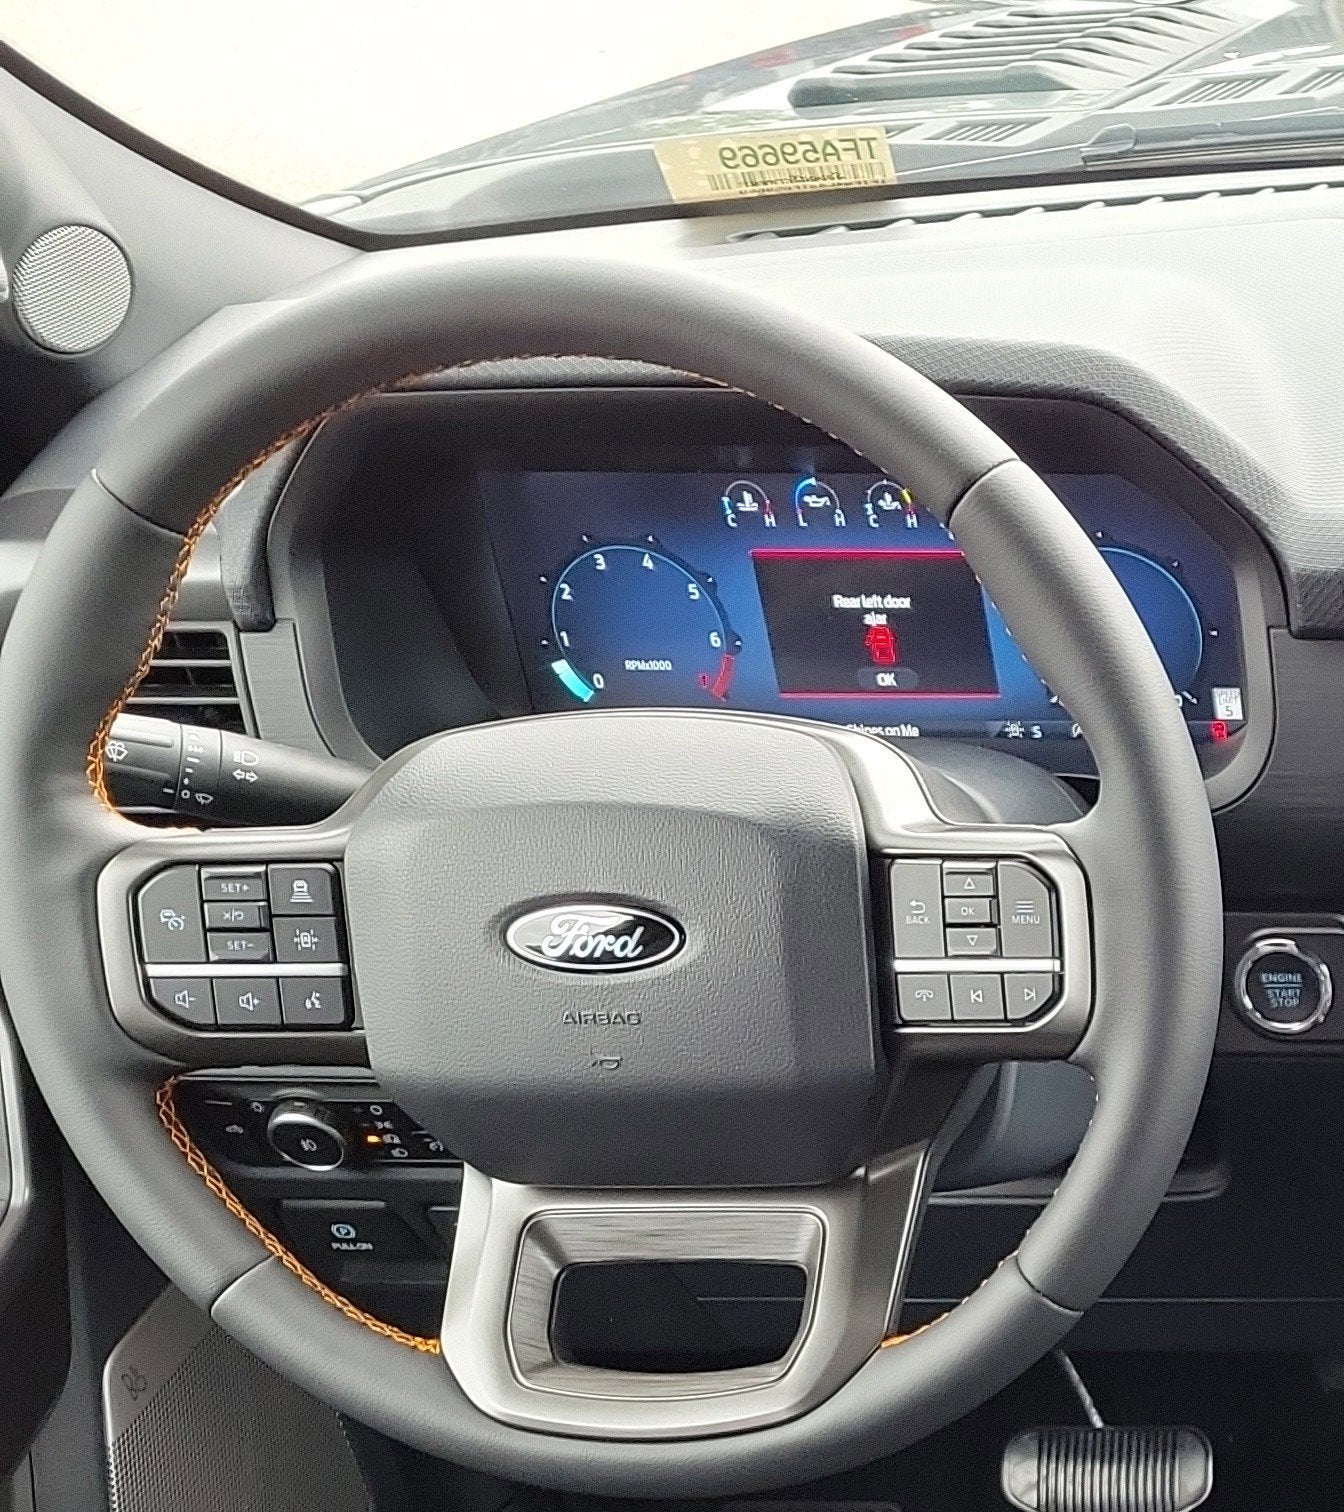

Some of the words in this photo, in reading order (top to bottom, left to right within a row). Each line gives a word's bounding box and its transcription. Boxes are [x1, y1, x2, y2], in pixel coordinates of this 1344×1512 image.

[726, 514, 738, 527] C
[764, 514, 776, 527] H
[799, 514, 808, 526] L
[834, 513, 846, 527] H
[869, 514, 879, 528] C
[906, 515, 918, 528] H
[593, 554, 606, 570] 3
[642, 553, 654, 570] 4
[560, 583, 573, 600] 2
[688, 584, 700, 600] 5
[832, 594, 860, 608] Rear
[861, 594, 883, 608] left
[885, 594, 911, 609] door
[863, 612, 888, 627] ajar
[560, 630, 570, 648] 1
[709, 632, 721, 648] 6
[593, 673, 604, 689] 0
[876, 672, 897, 687] OK
[1226, 706, 1234, 717] 5
[961, 907, 975, 915] OK
[906, 915, 930, 925] BACK
[1011, 915, 1040, 925] MENU
[541, 913, 645, 959] Ford
[1270, 998, 1300, 1008] STOP
[562, 1011, 643, 1026] AIRBAG
